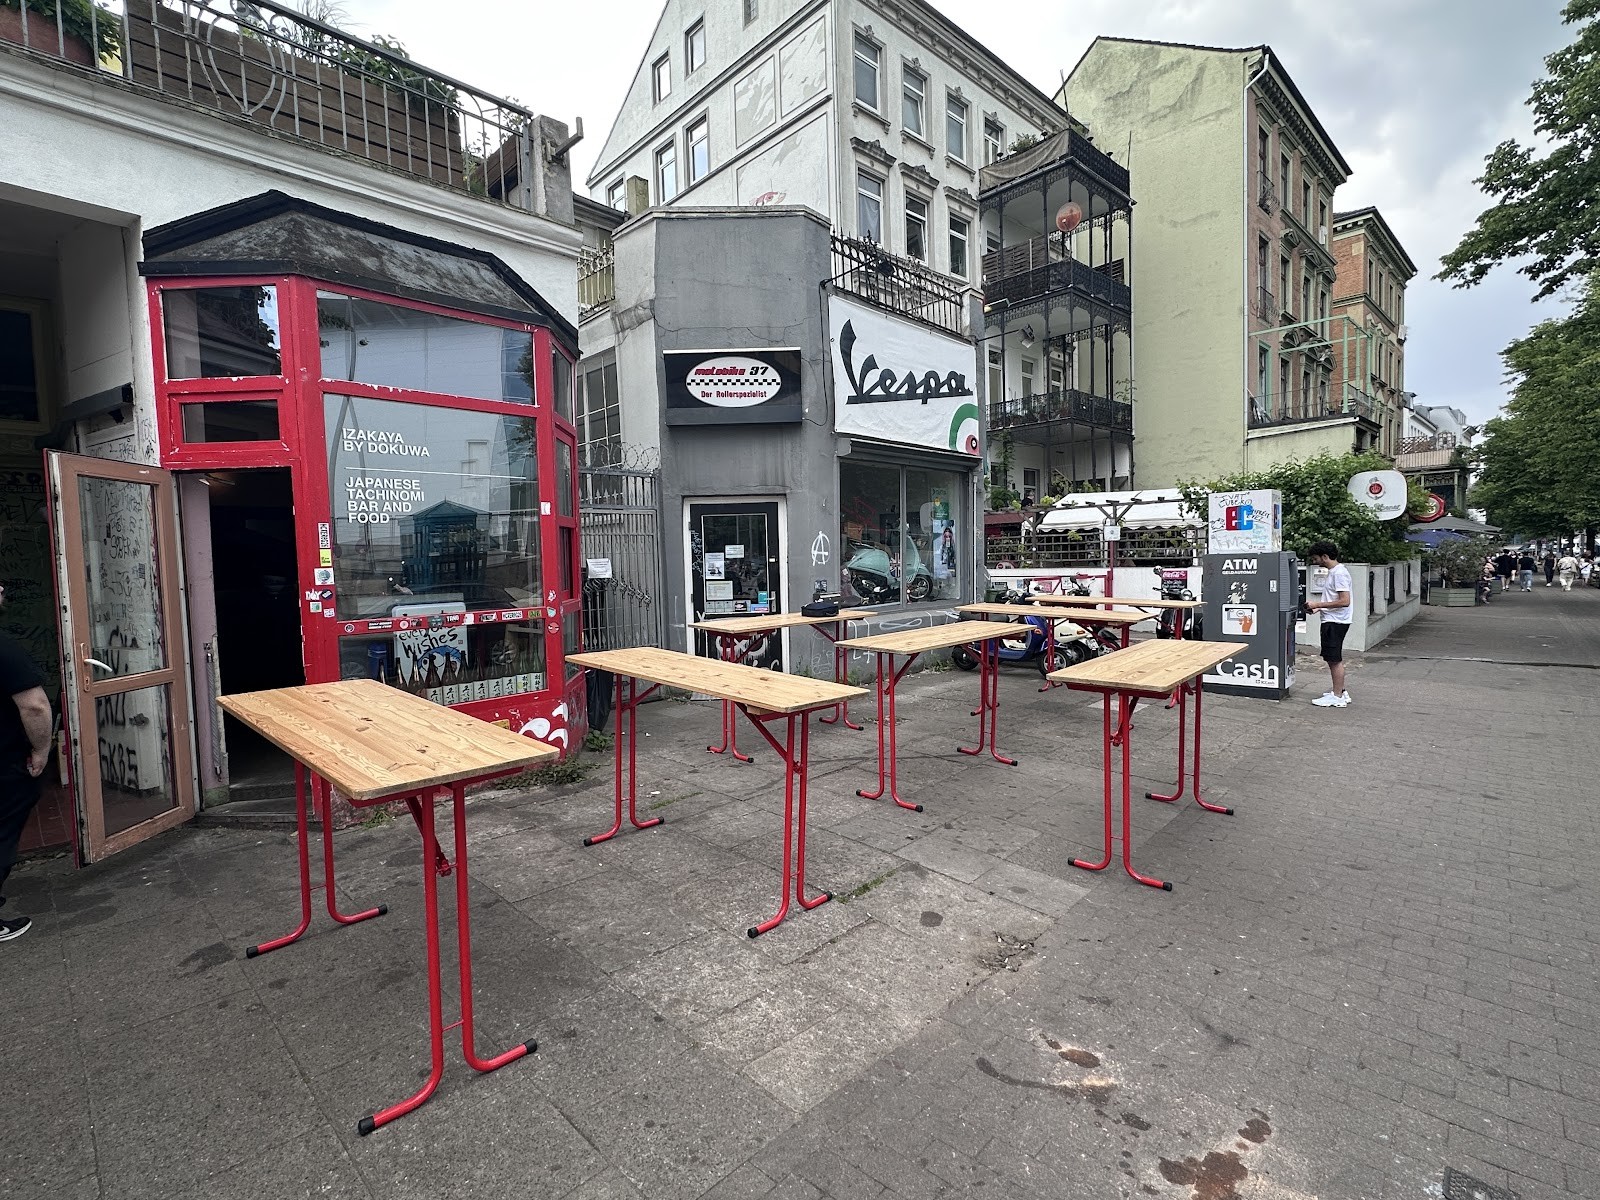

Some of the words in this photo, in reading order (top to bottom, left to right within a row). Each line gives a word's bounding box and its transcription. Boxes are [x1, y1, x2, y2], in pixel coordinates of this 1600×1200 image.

[840, 319, 973, 405] Vespa
[749, 366, 769, 376] 37
[716, 390, 767, 399] Rollerspezialist
[342, 427, 405, 444] IZAKAYA
[343, 440, 364, 453] BY
[367, 442, 431, 457] DOKUWA
[345, 476, 421, 490] JAPANESE
[346, 488, 425, 502] TACHINOMI
[347, 500, 379, 512] BAR
[382, 501, 413, 513] AND
[348, 512, 390, 524] FOOD
[1222, 558, 1258, 570] ATM
[1215, 658, 1279, 680] Cash
